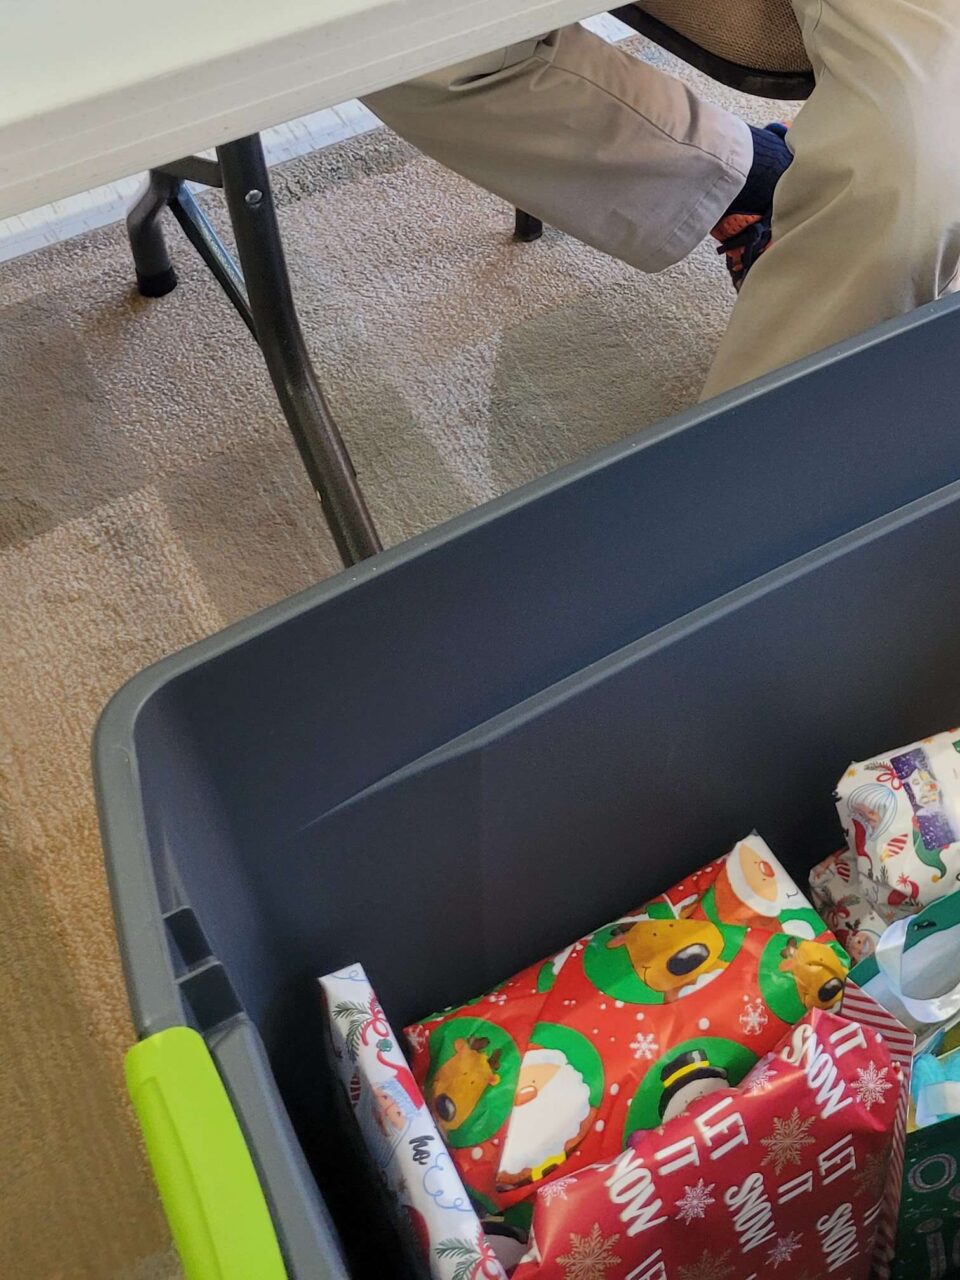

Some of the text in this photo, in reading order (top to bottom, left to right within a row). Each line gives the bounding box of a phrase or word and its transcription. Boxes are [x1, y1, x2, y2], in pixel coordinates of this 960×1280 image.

[780, 1023, 853, 1120] SNOW
[830, 1022, 867, 1059] IT
[653, 1136, 700, 1176] IT
[694, 1096, 749, 1161] LET
[817, 1133, 857, 1186] LET
[604, 1147, 669, 1238] NOW
[723, 1172, 777, 1254] SNOW
[777, 1170, 813, 1205] IT
[816, 1202, 860, 1273] SNOW
